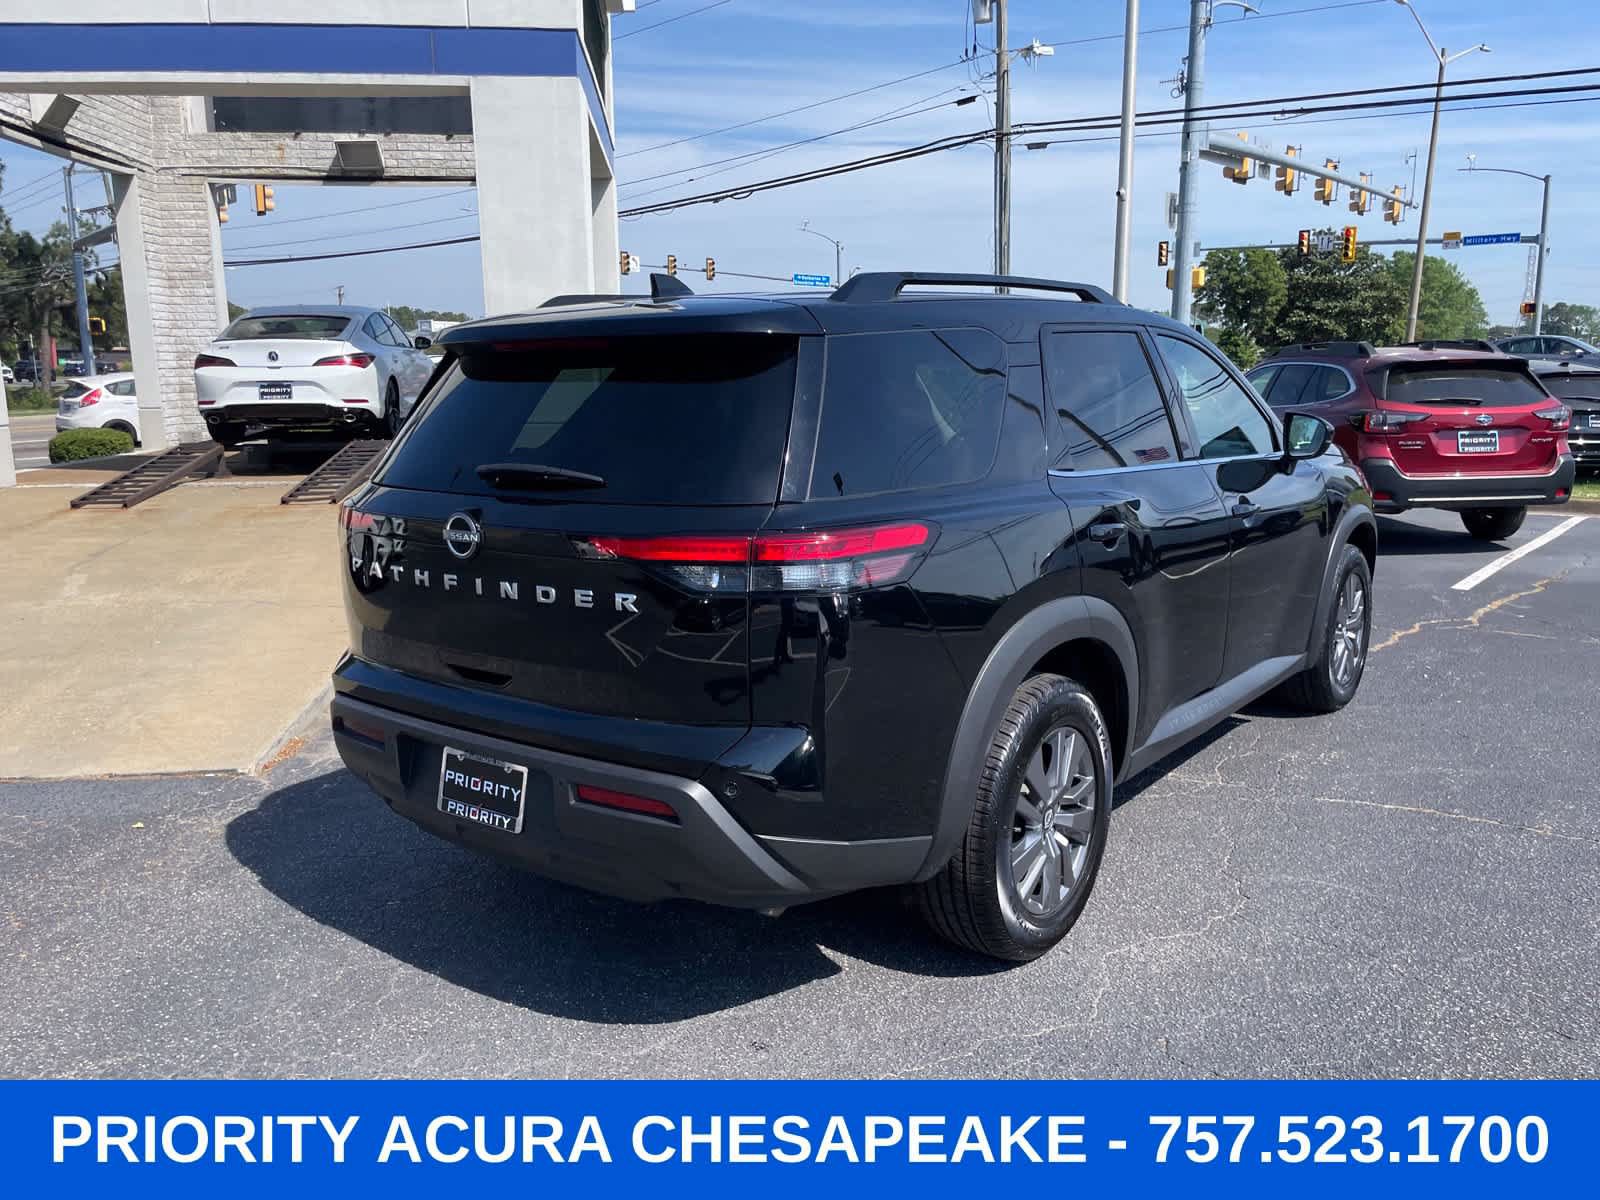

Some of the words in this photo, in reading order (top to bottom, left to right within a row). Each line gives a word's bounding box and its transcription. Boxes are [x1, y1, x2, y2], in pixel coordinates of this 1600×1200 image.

[1460, 436, 1496, 444] PRIORITY
[446, 531, 479, 542] ISSAN
[352, 557, 640, 613] PATHFINDER
[445, 769, 521, 802] PRIORITY
[447, 801, 511, 828] PRIORITY
